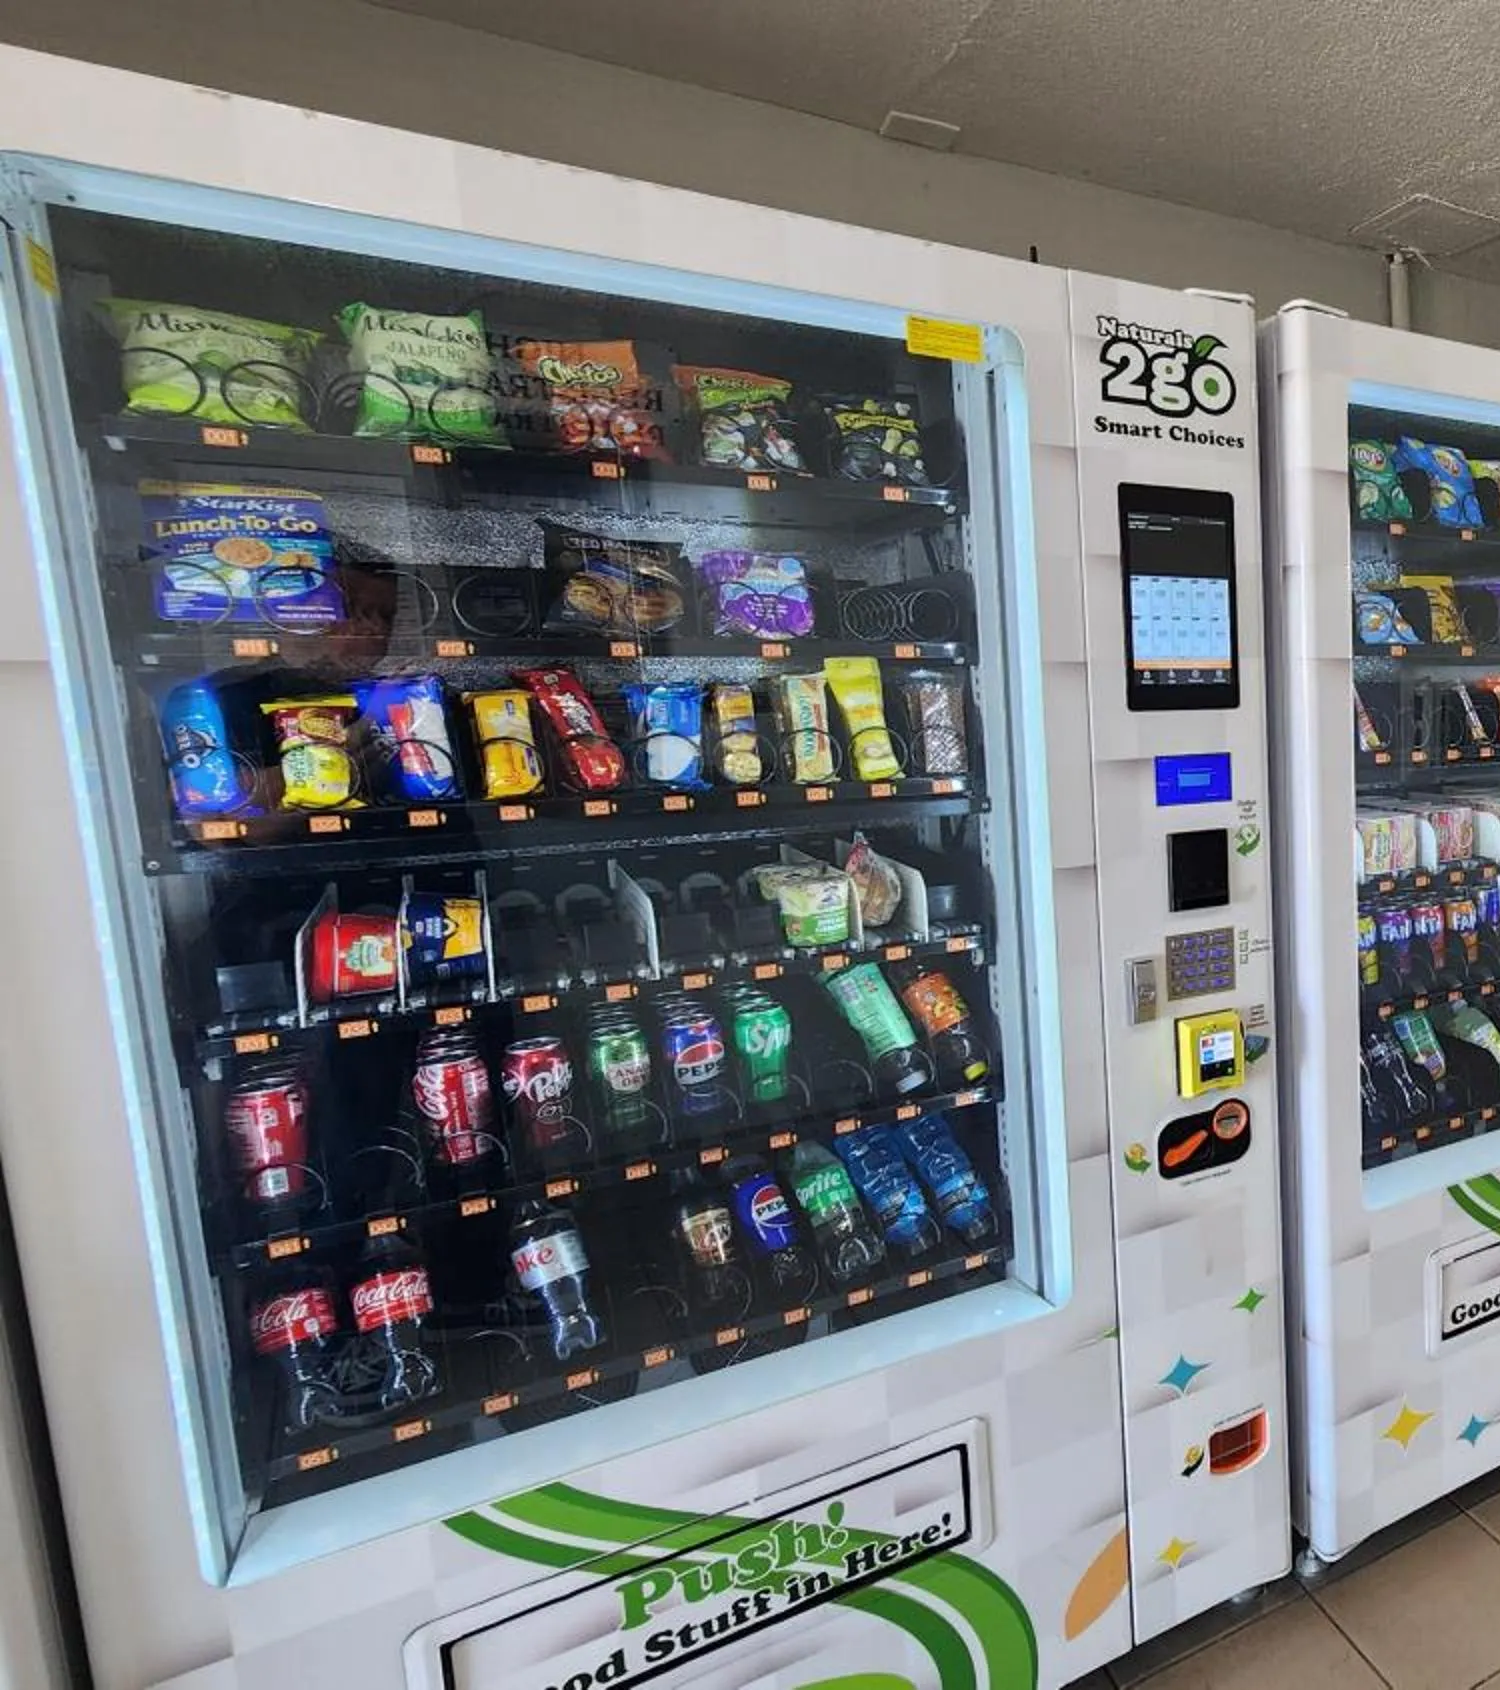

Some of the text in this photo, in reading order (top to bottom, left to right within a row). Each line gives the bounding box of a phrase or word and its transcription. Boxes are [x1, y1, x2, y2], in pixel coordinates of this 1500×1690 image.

[1097, 315, 1195, 349] Naturals
[1094, 416, 1245, 449] Smart Choices
[614, 1501, 852, 1632] Push!
[644, 1586, 772, 1663] Stuff
[787, 1573, 831, 1604] in
[842, 1512, 952, 1580] Here!
